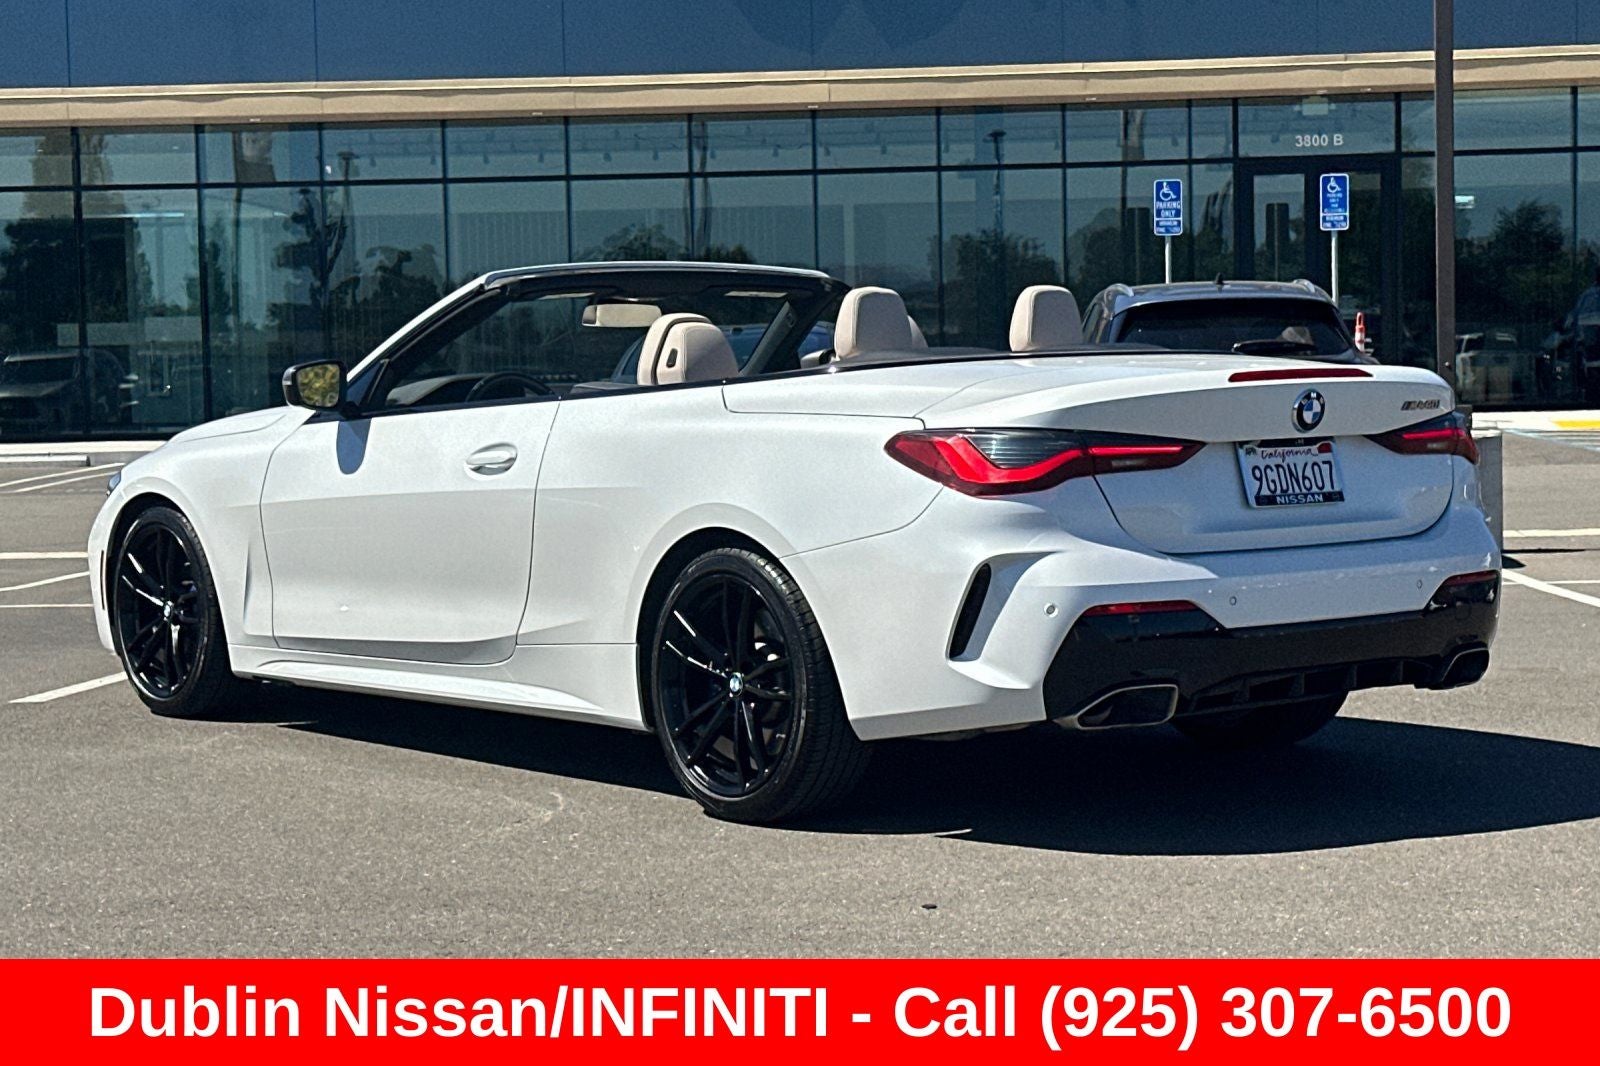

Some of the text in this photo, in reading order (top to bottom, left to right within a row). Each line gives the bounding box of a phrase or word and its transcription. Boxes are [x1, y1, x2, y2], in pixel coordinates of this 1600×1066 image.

[1295, 133, 1344, 147] 3800 B
[1156, 201, 1181, 209] PARKING
[1261, 448, 1319, 463] California
[1251, 460, 1335, 496] 9GDN607
[1276, 493, 1324, 505] NISSAN
